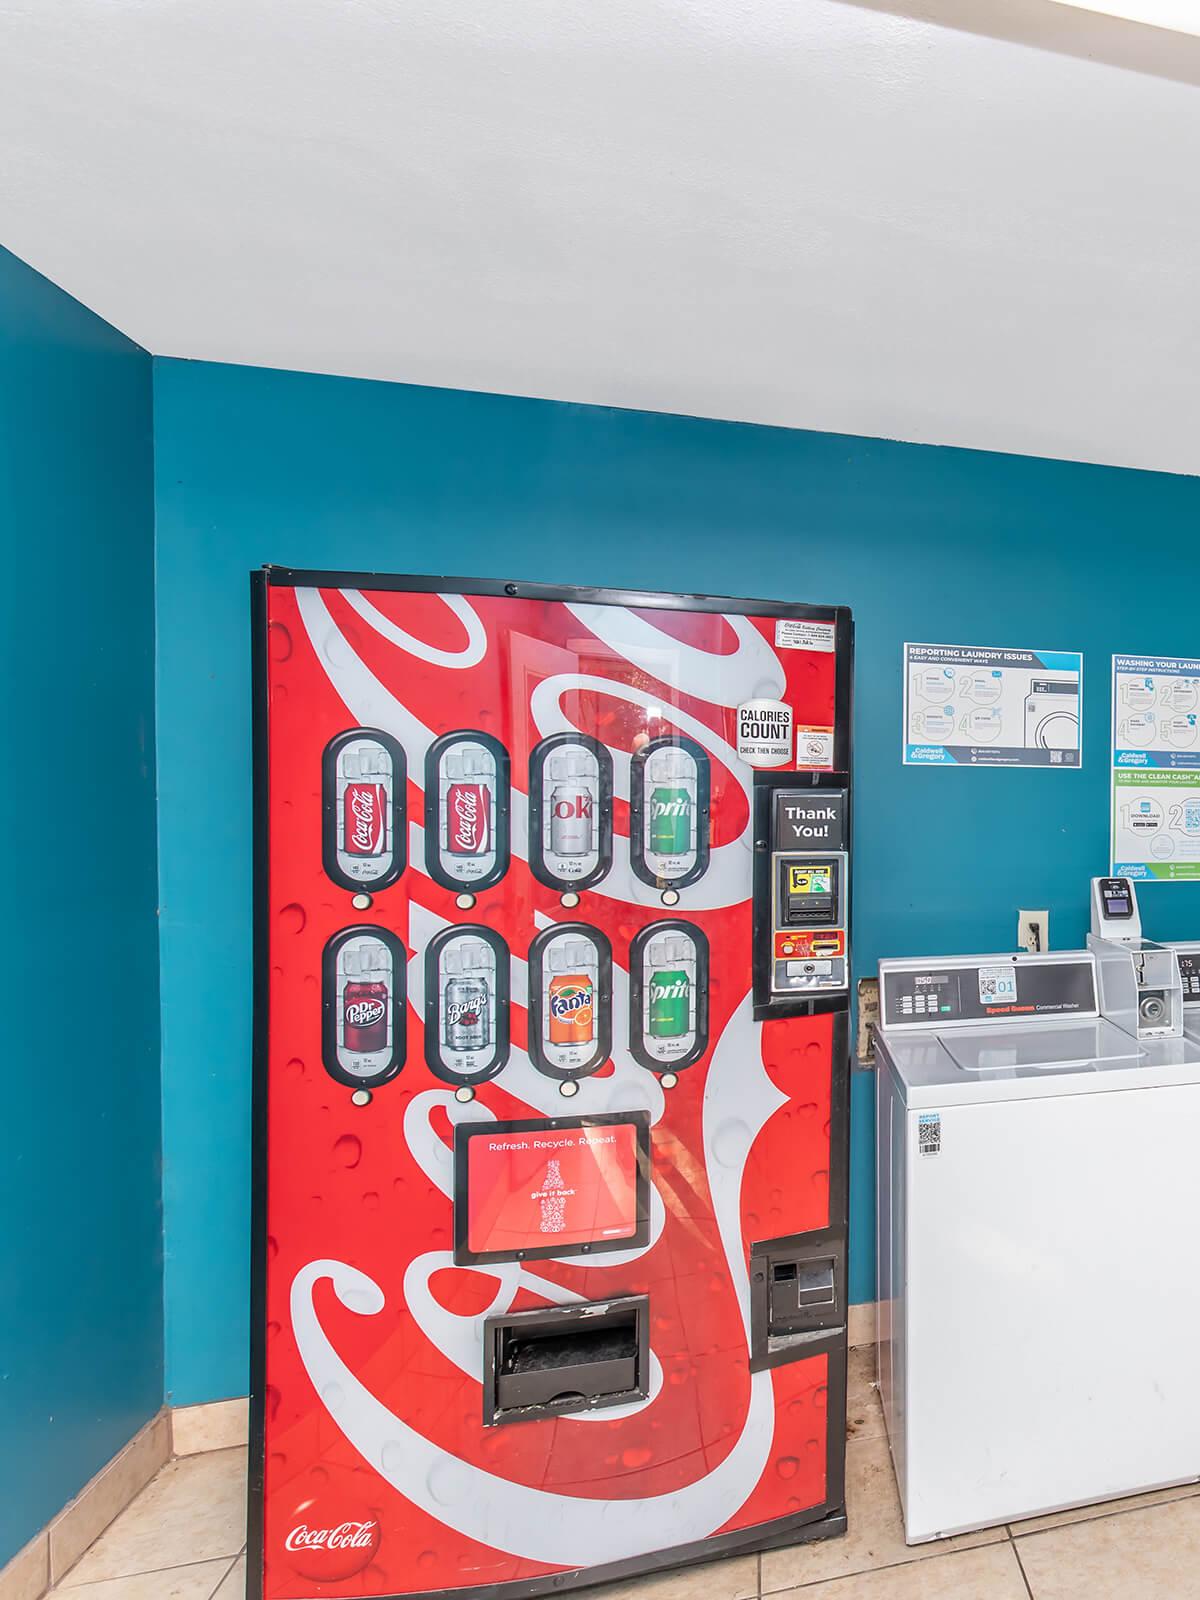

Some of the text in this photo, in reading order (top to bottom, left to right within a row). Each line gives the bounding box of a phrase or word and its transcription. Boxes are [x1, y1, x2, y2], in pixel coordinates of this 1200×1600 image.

[909, 648, 1033, 662] REPORTING LAUNDRY ISSUES
[1116, 658, 1154, 668] WASHING
[1156, 660, 1178, 670] YOUR
[740, 709, 790, 723] CALORIES
[740, 722, 790, 740] COUNT
[771, 748, 789, 756] CHOOSE
[785, 807, 837, 820] Thank
[792, 824, 829, 838] You!
[998, 981, 1014, 992] 01
[350, 1004, 383, 1024] Pepper
[360, 1002, 375, 1013] Dr
[448, 994, 487, 1024] Barq's
[489, 1136, 617, 1152] Refresh. Recycle. Repeat.
[531, 1190, 548, 1199] give
[556, 1188, 574, 1196] back
[285, 1520, 377, 1552] Coca-Cola
